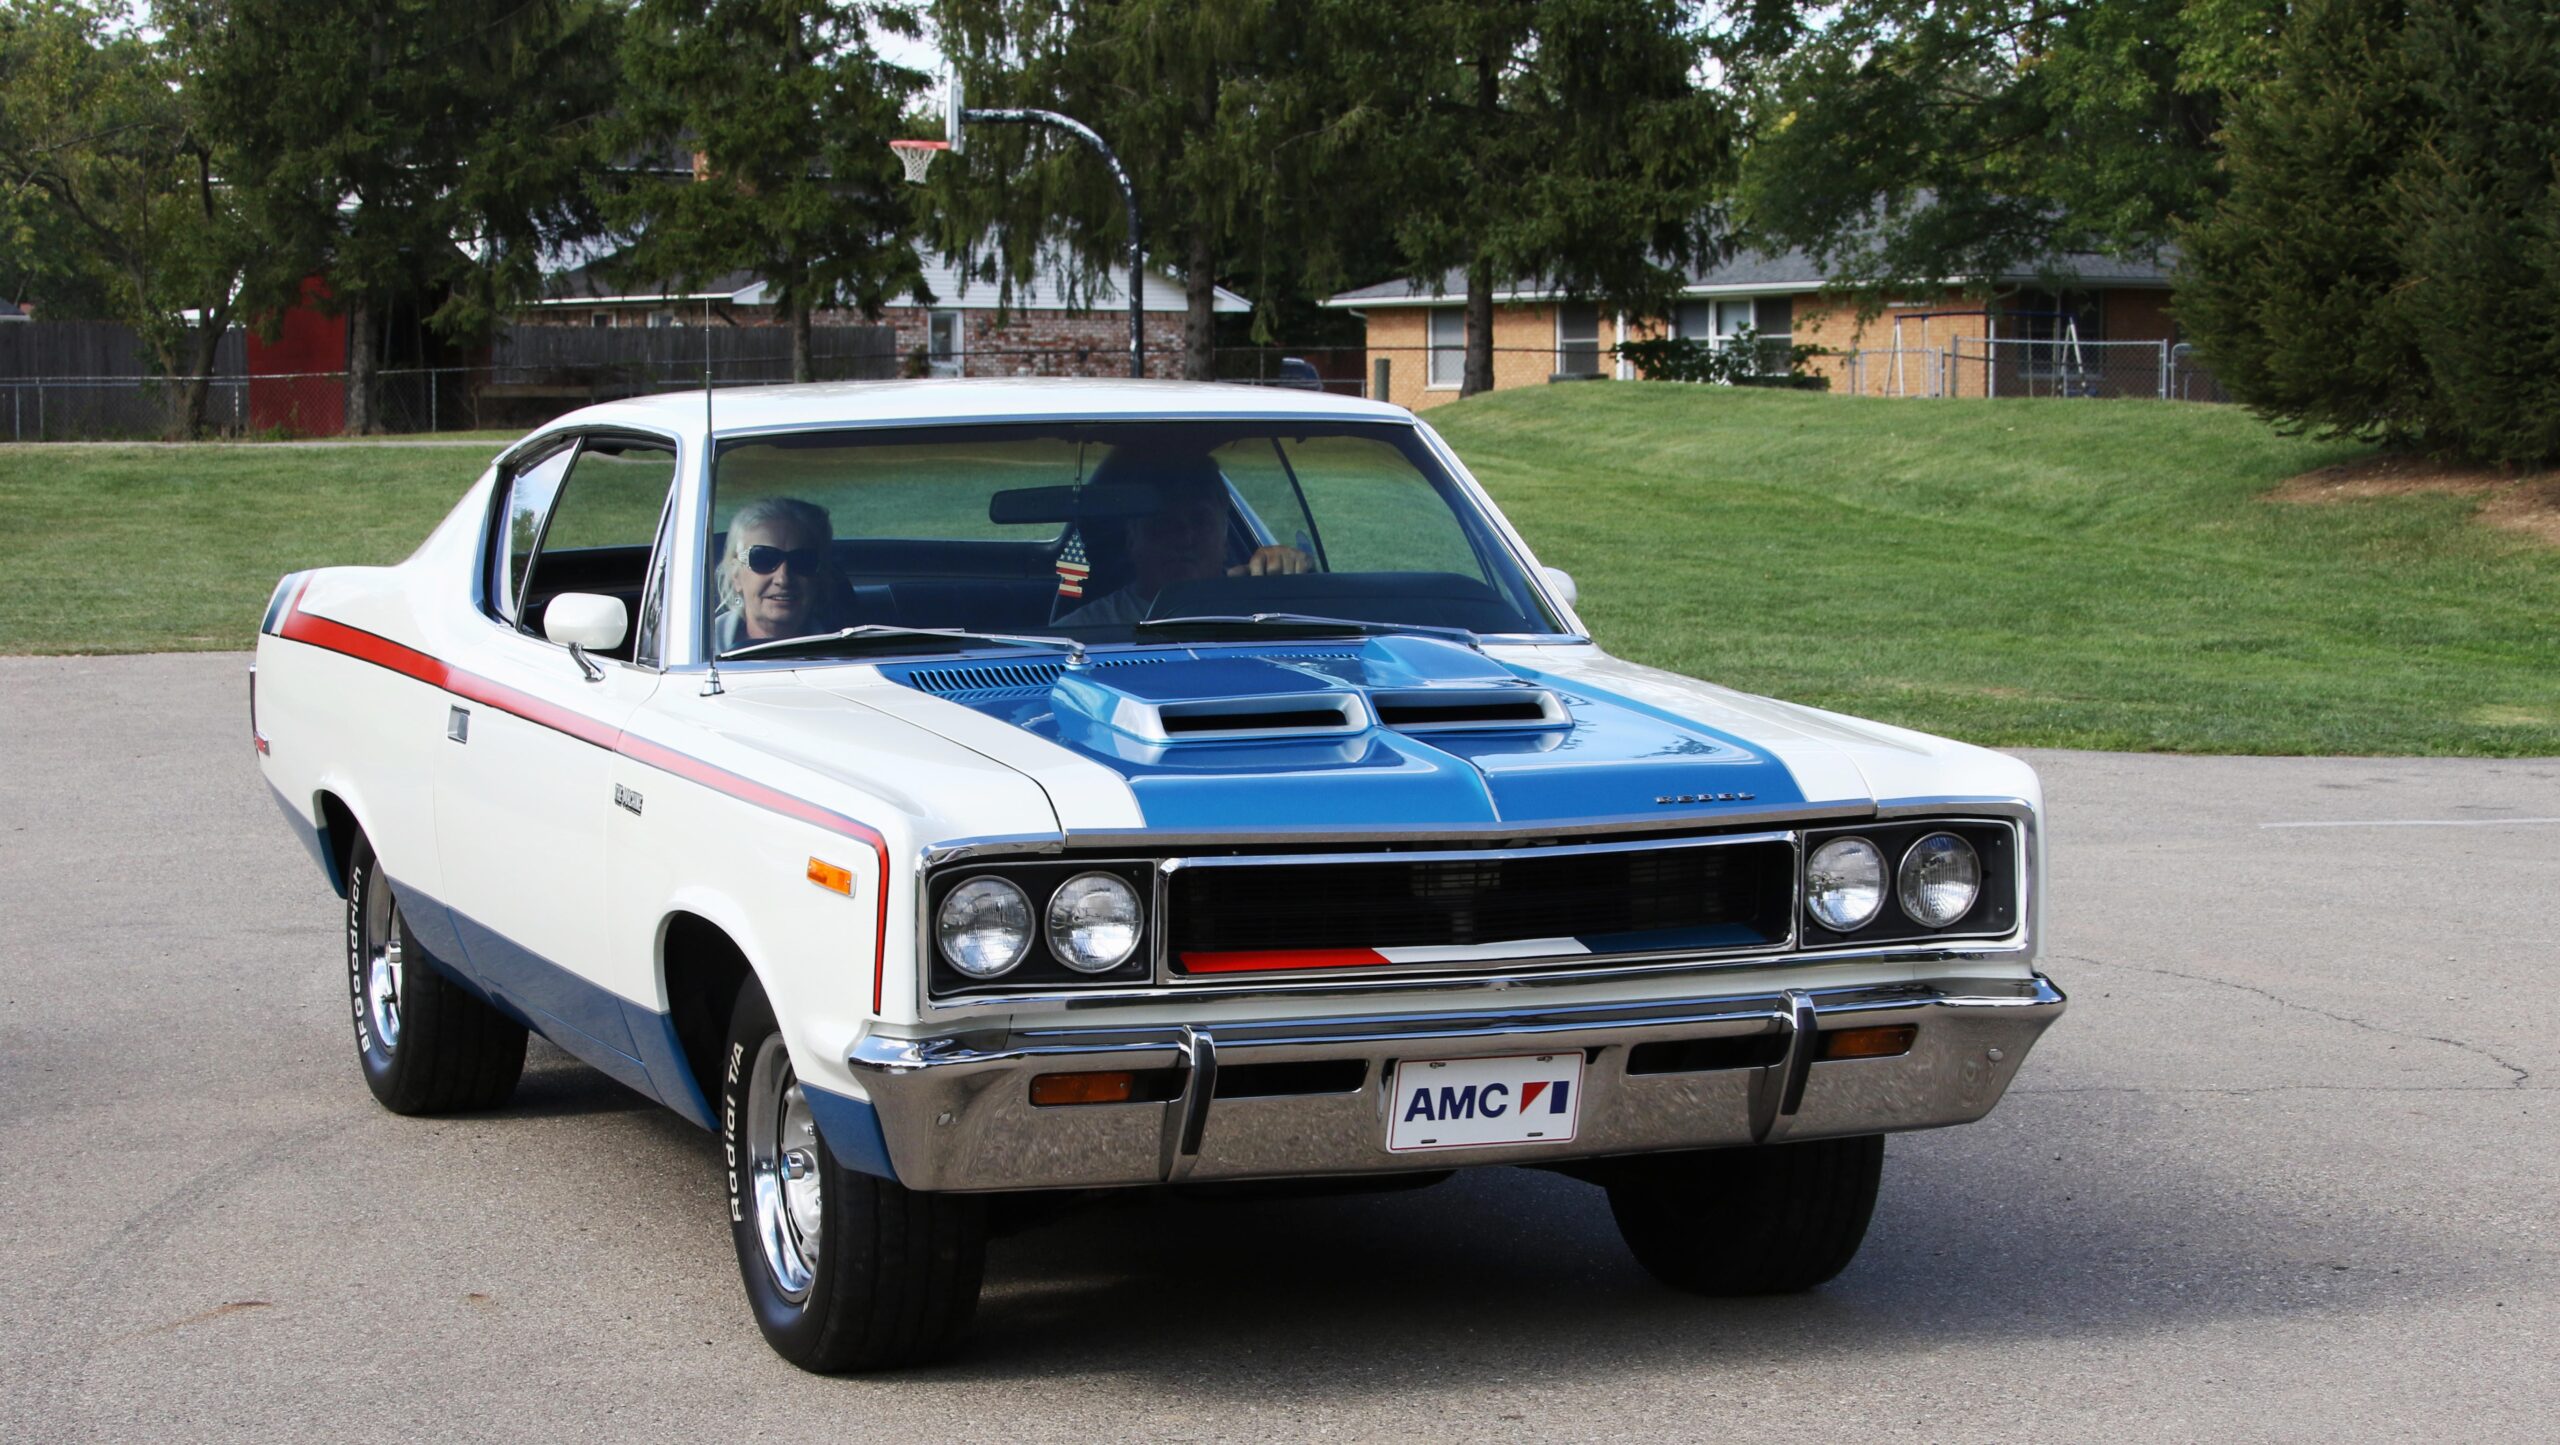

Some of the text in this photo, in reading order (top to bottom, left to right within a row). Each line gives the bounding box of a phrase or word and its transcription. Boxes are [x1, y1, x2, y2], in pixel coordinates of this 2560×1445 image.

[1655, 792, 1755, 804] REBEL
[350, 866, 371, 1053] BFGoodrich
[725, 1041, 744, 1222] Radial T/A
[1404, 1083, 1509, 1122] AMC
